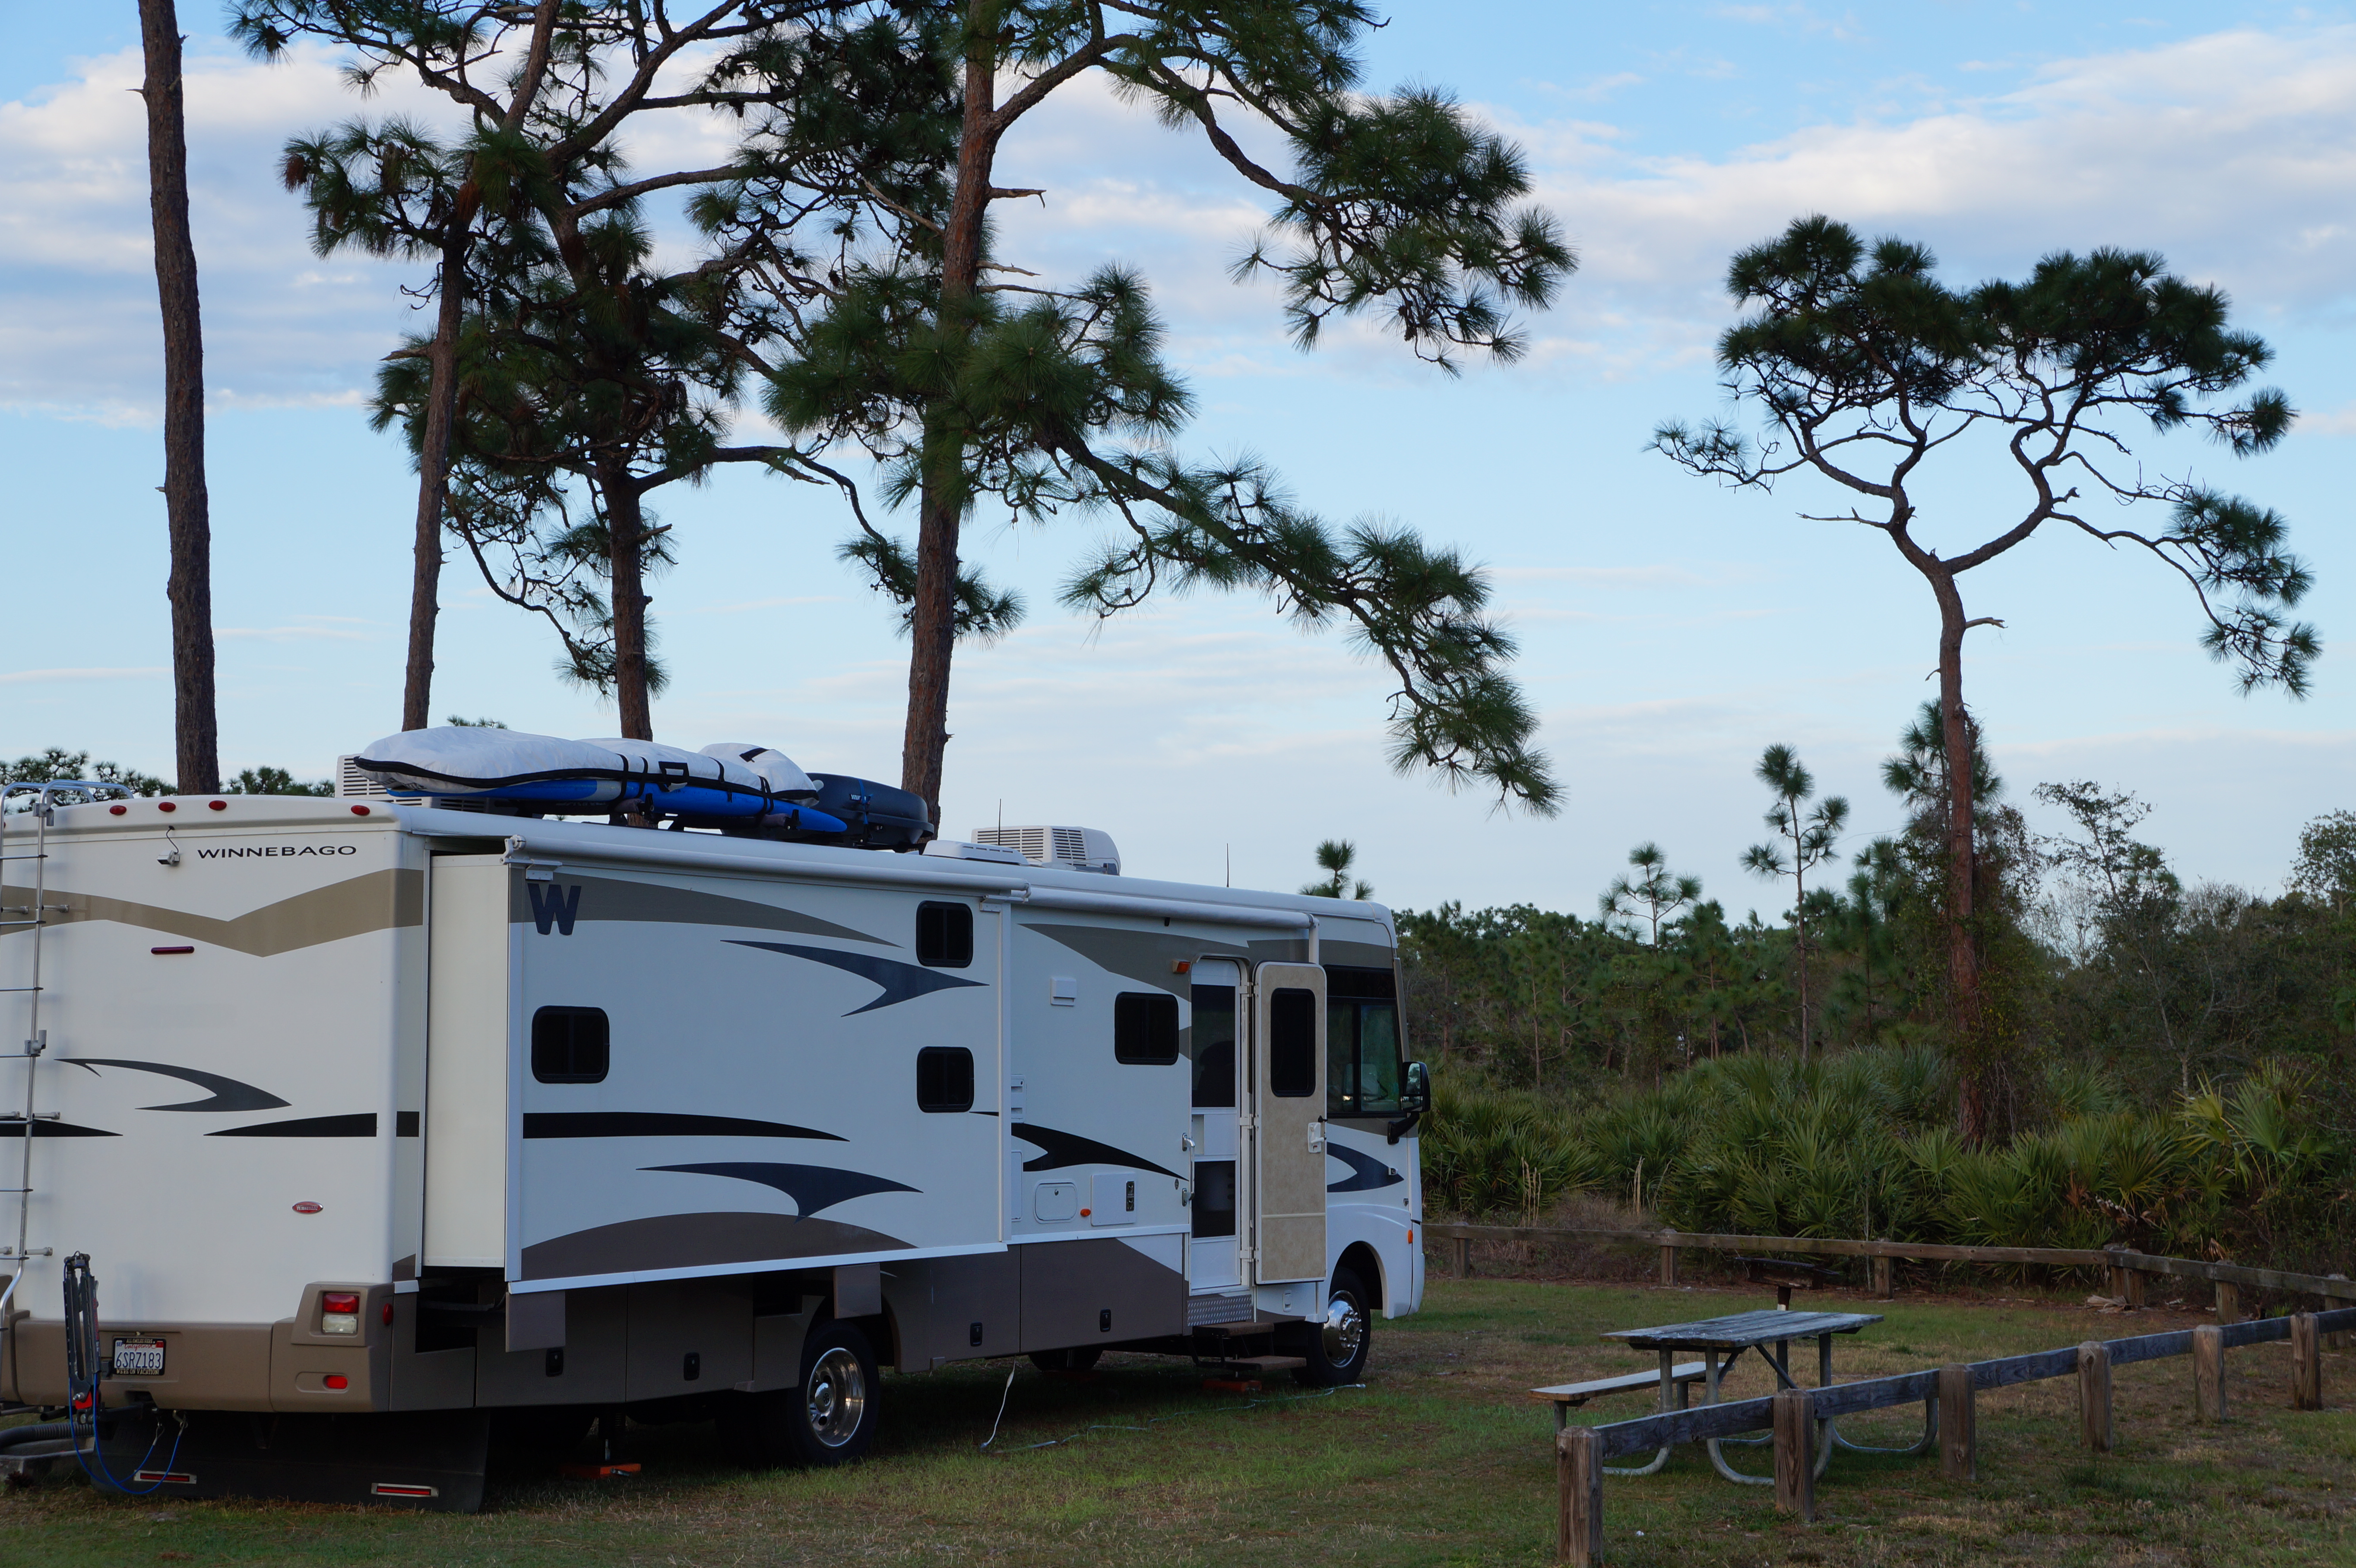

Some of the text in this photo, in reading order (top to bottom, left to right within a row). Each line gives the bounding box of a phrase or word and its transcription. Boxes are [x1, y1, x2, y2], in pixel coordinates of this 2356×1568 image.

[197, 846, 357, 859] WINNEBAGO
[527, 883, 582, 936] W
[116, 1352, 161, 1368] 6SRZ183
